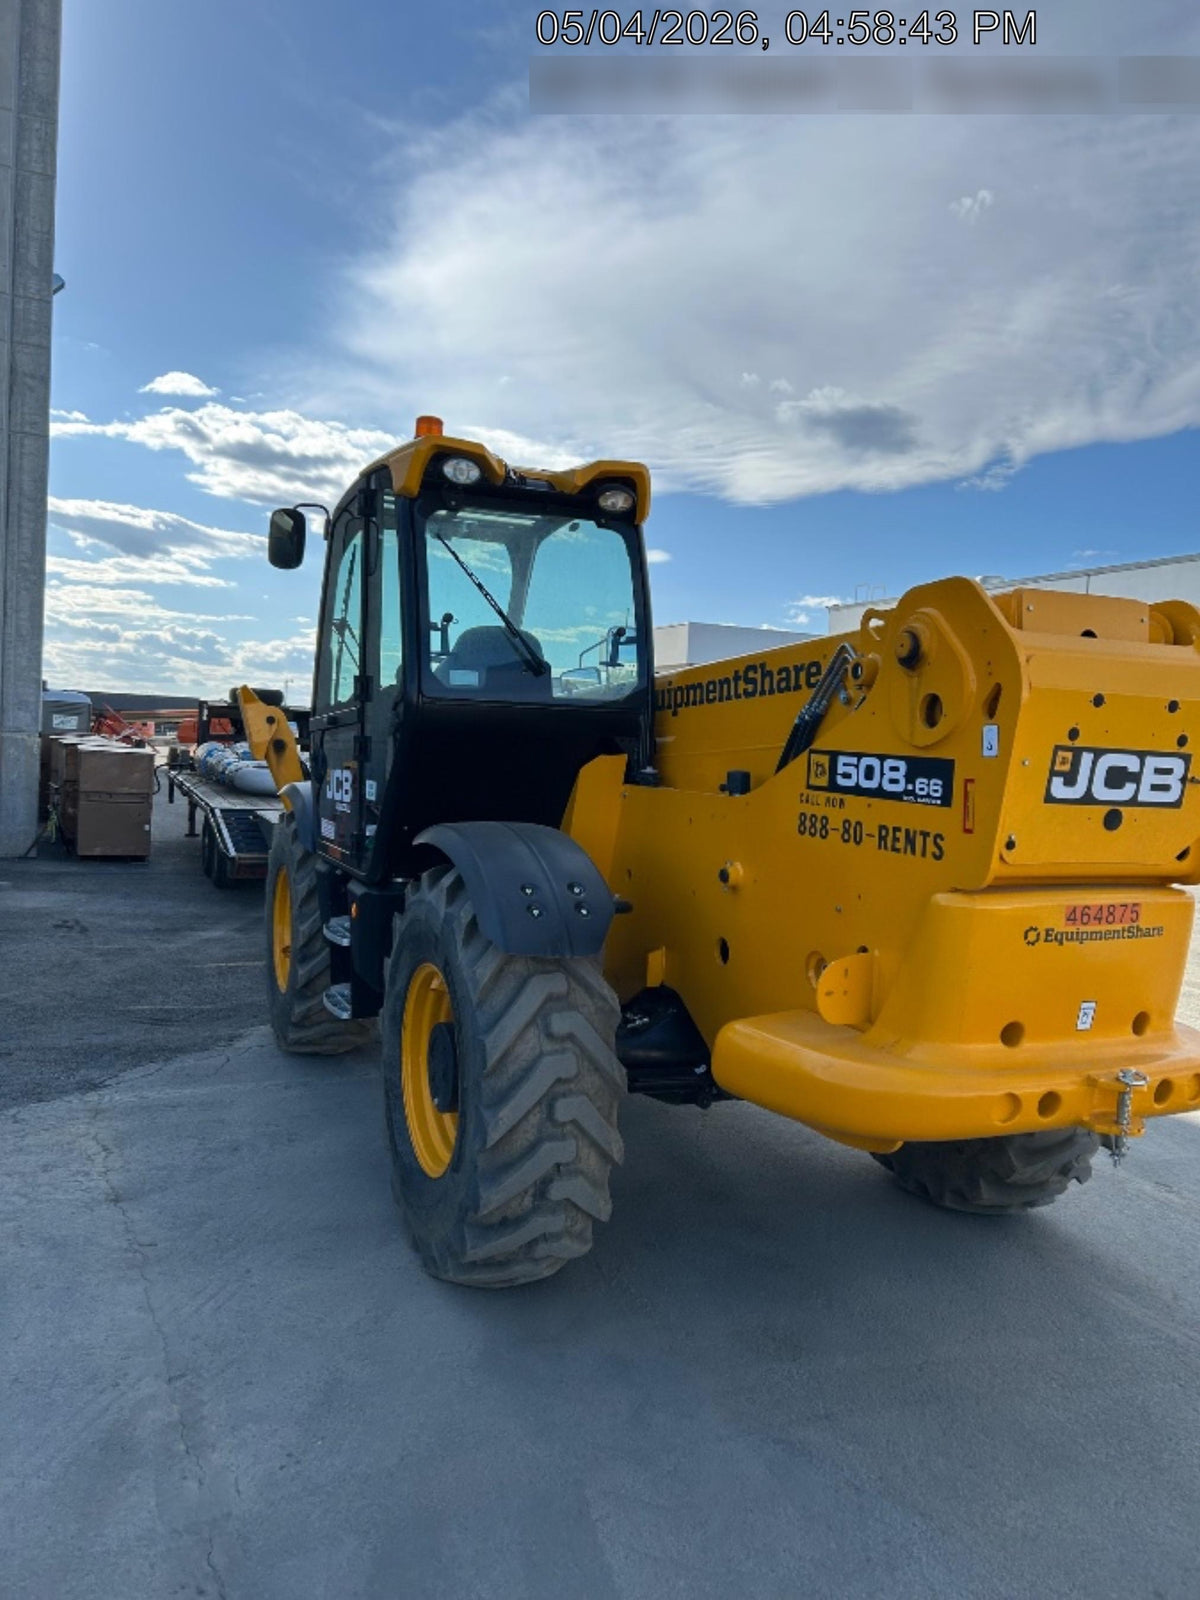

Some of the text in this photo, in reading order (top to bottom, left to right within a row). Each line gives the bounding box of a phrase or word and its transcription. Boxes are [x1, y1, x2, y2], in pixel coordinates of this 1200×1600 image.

[655, 660, 822, 716] uipmentShare
[326, 769, 353, 802] JCB
[1050, 751, 1186, 803] JCB
[797, 811, 945, 861] 888-80-RENTS
[1043, 924, 1164, 946] EquipmentShare
[1066, 903, 1140, 926] 464875
